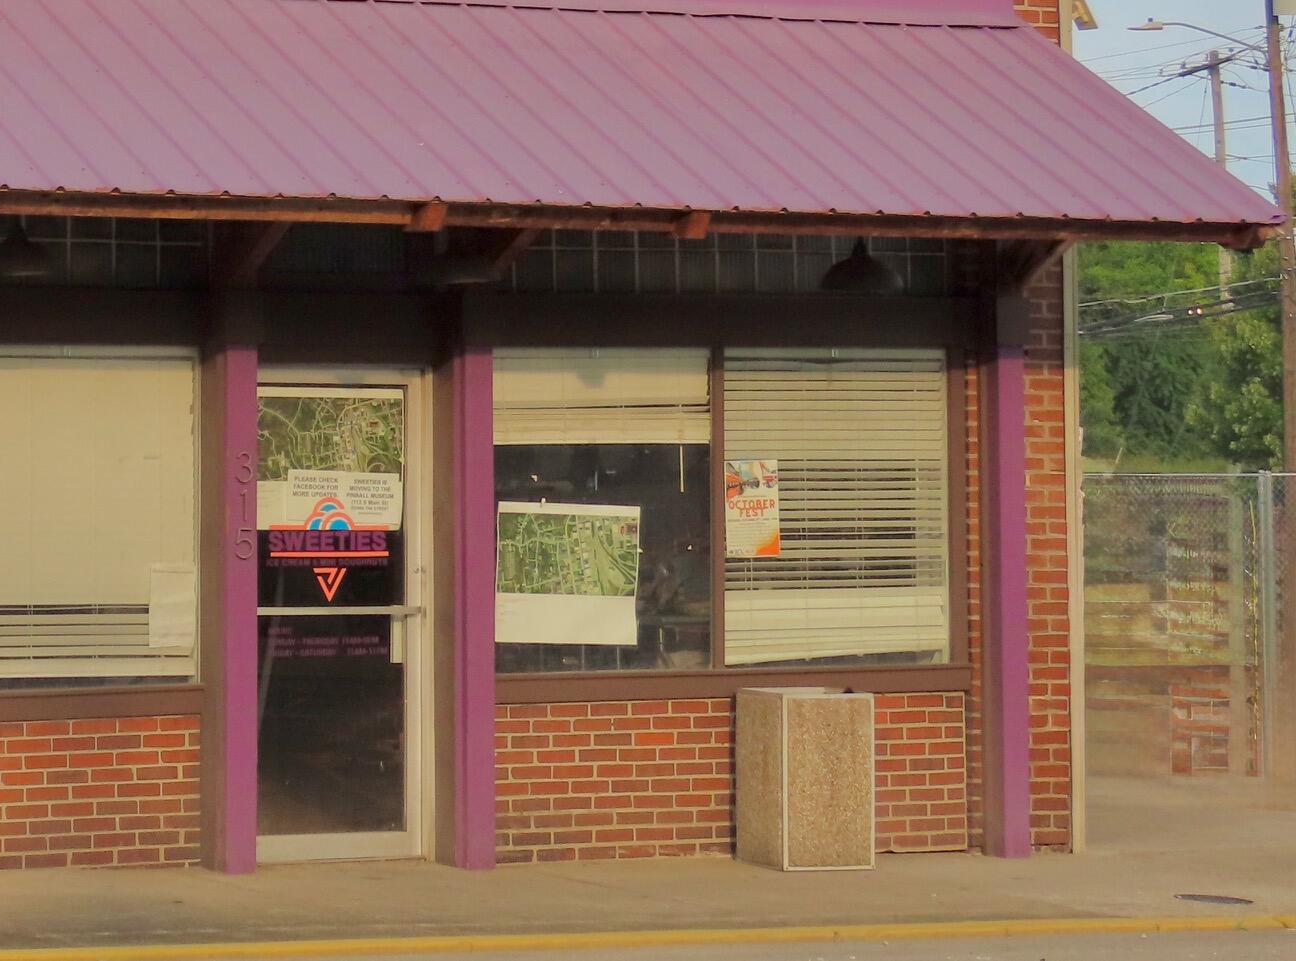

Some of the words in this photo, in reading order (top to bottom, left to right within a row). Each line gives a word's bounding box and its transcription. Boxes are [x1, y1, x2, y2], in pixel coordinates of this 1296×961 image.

[235, 452, 254, 560] 315
[729, 499, 775, 510] OCTOBER
[739, 509, 764, 518] FEST
[268, 531, 386, 551] SWEETIES
